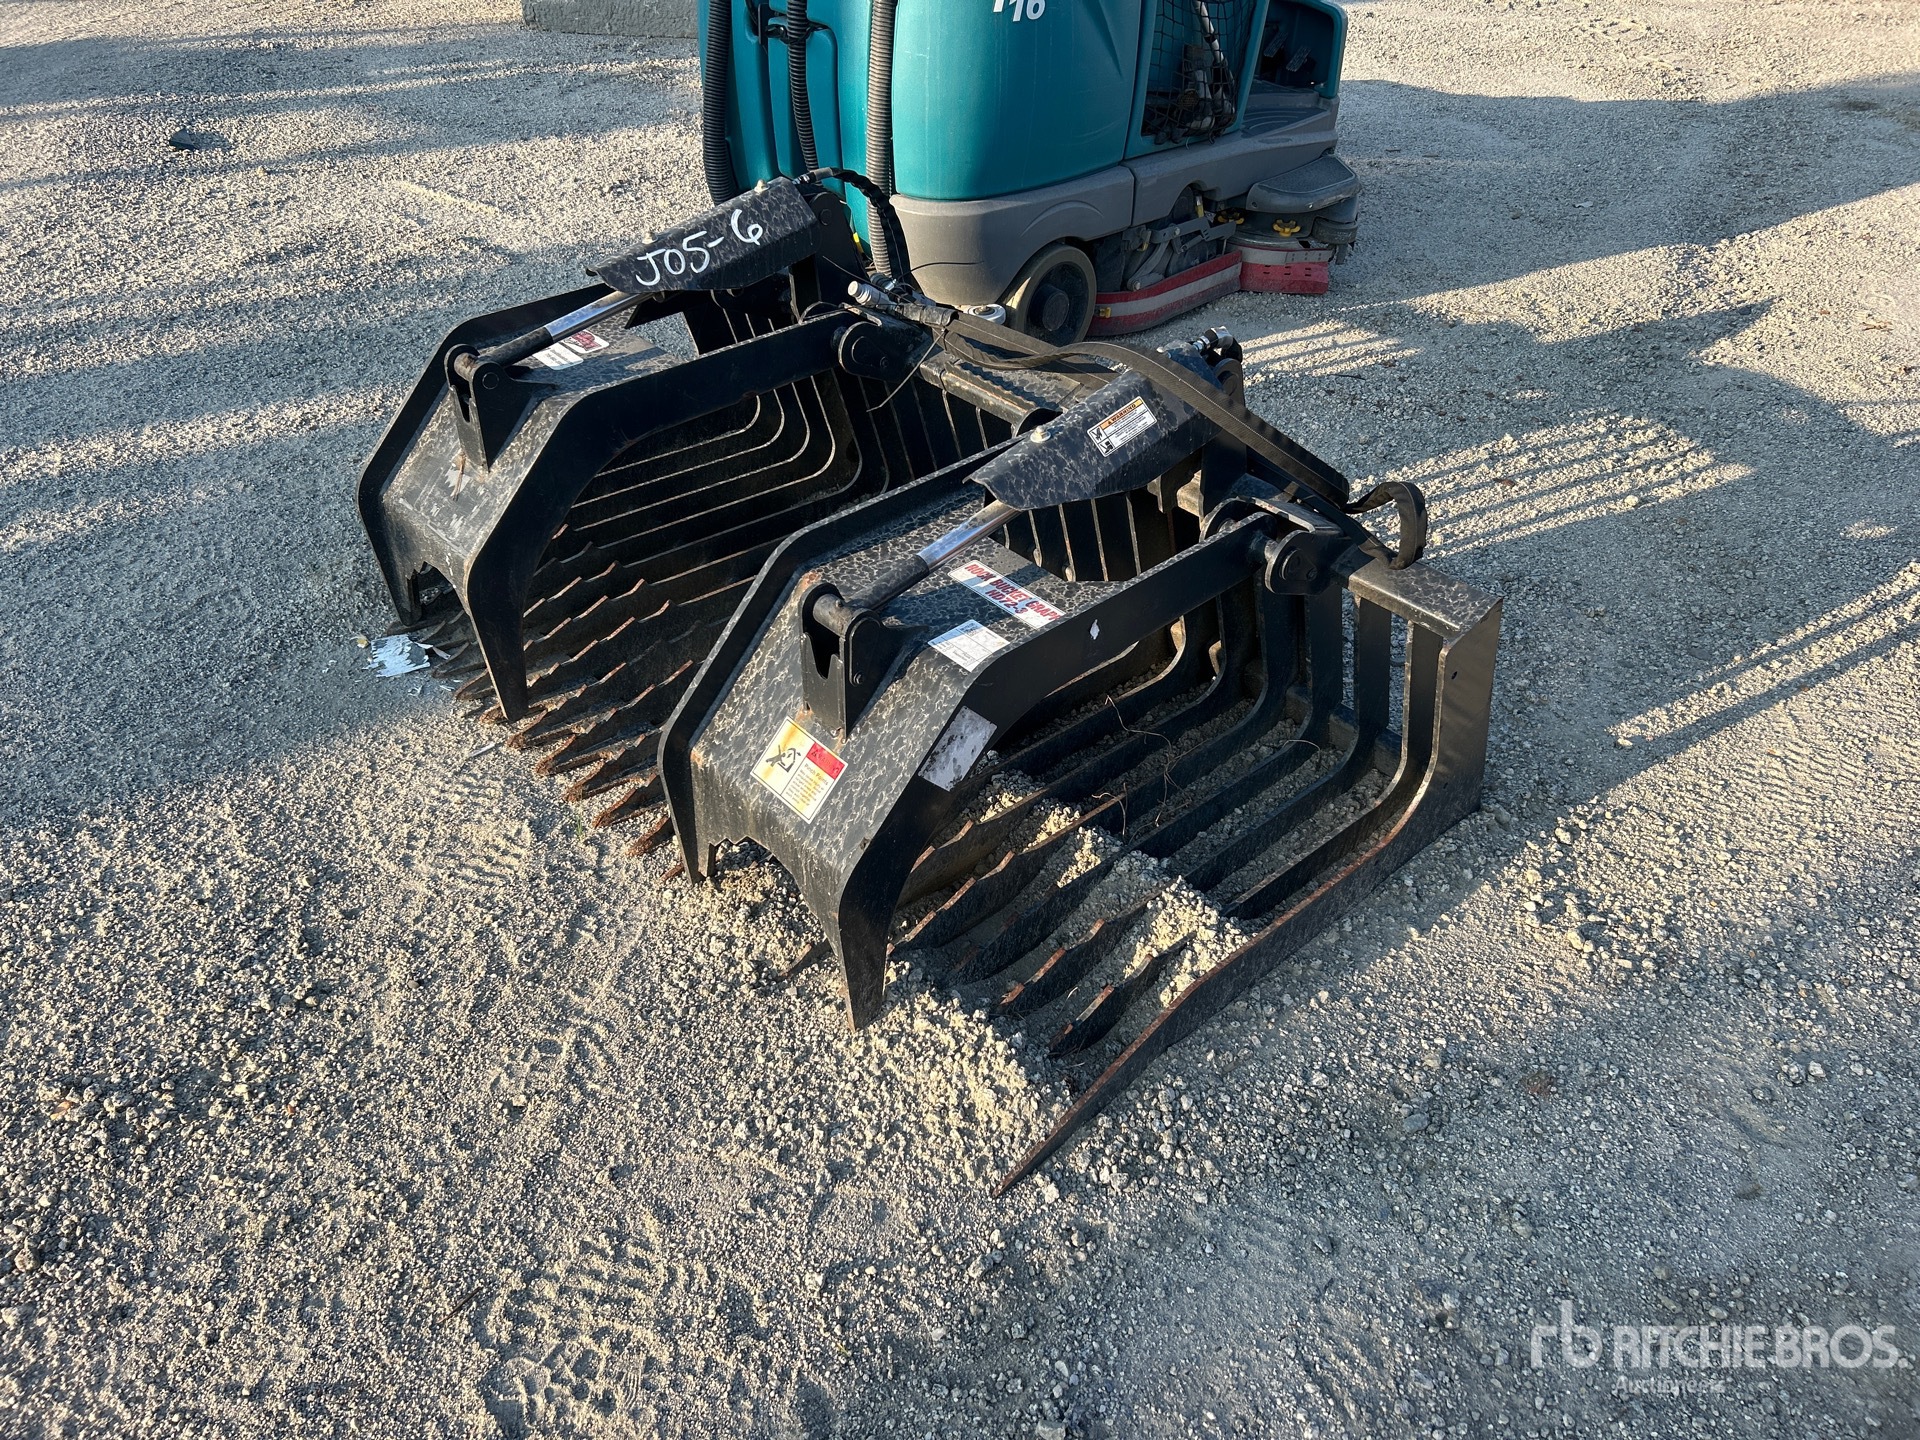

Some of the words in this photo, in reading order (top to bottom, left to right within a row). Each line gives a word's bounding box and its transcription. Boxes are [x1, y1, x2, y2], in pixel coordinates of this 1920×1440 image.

[1112, 403, 1136, 422] WARNING
[964, 563, 996, 582] ROCK
[990, 578, 1032, 603] BUCKET
